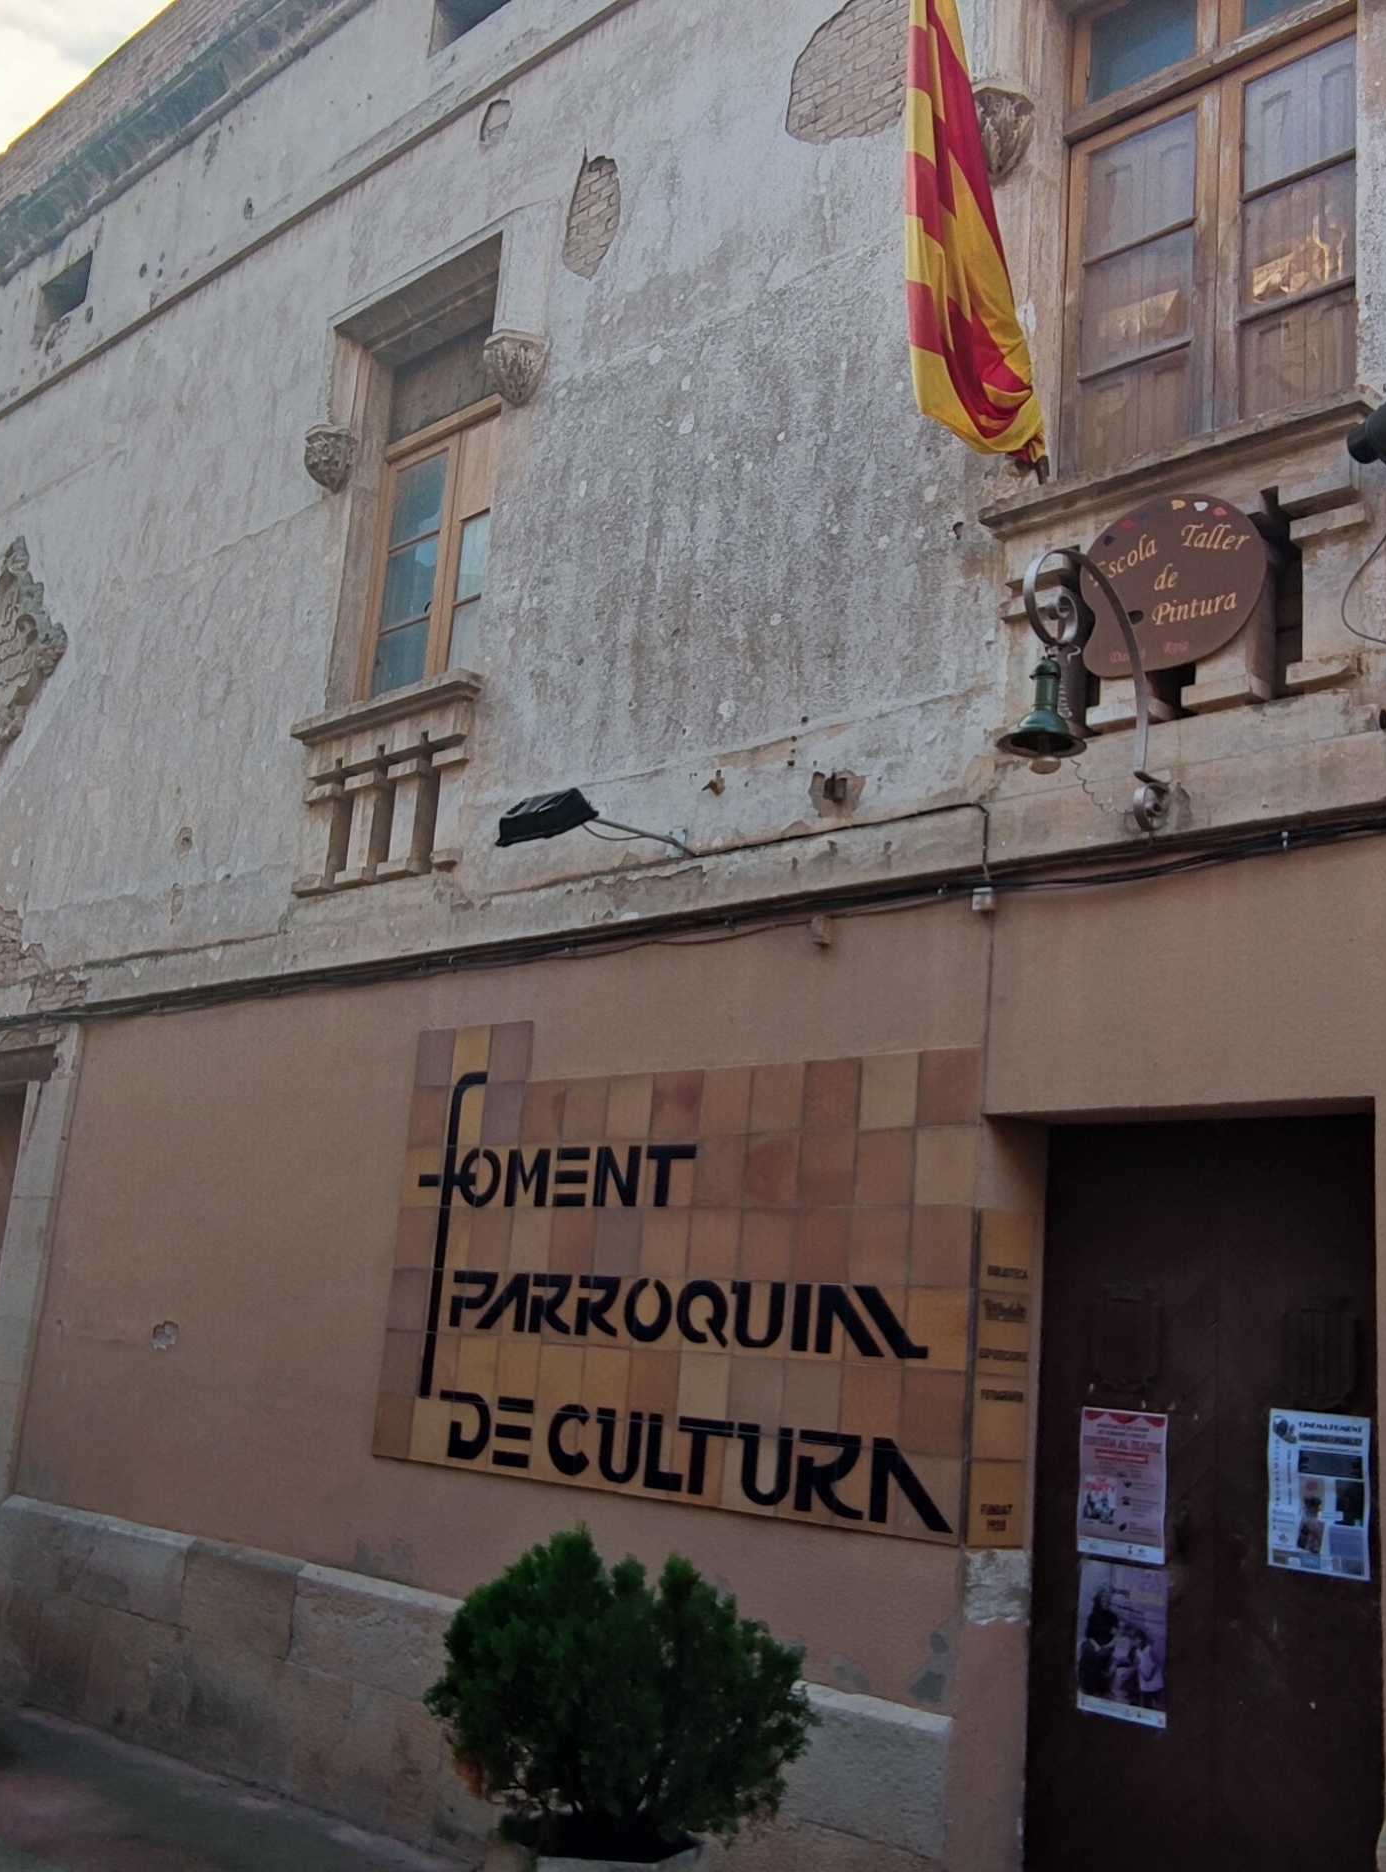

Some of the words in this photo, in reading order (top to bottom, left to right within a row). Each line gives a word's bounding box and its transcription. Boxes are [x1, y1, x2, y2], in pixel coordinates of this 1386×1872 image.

[1180, 522, 1251, 551] Taller
[1153, 564, 1179, 592] de
[1151, 590, 1238, 626] Pintura
[449, 1270, 928, 1360] PARROQUIAL
[440, 1390, 535, 1469] DE
[547, 1403, 954, 1534] CULTURA
